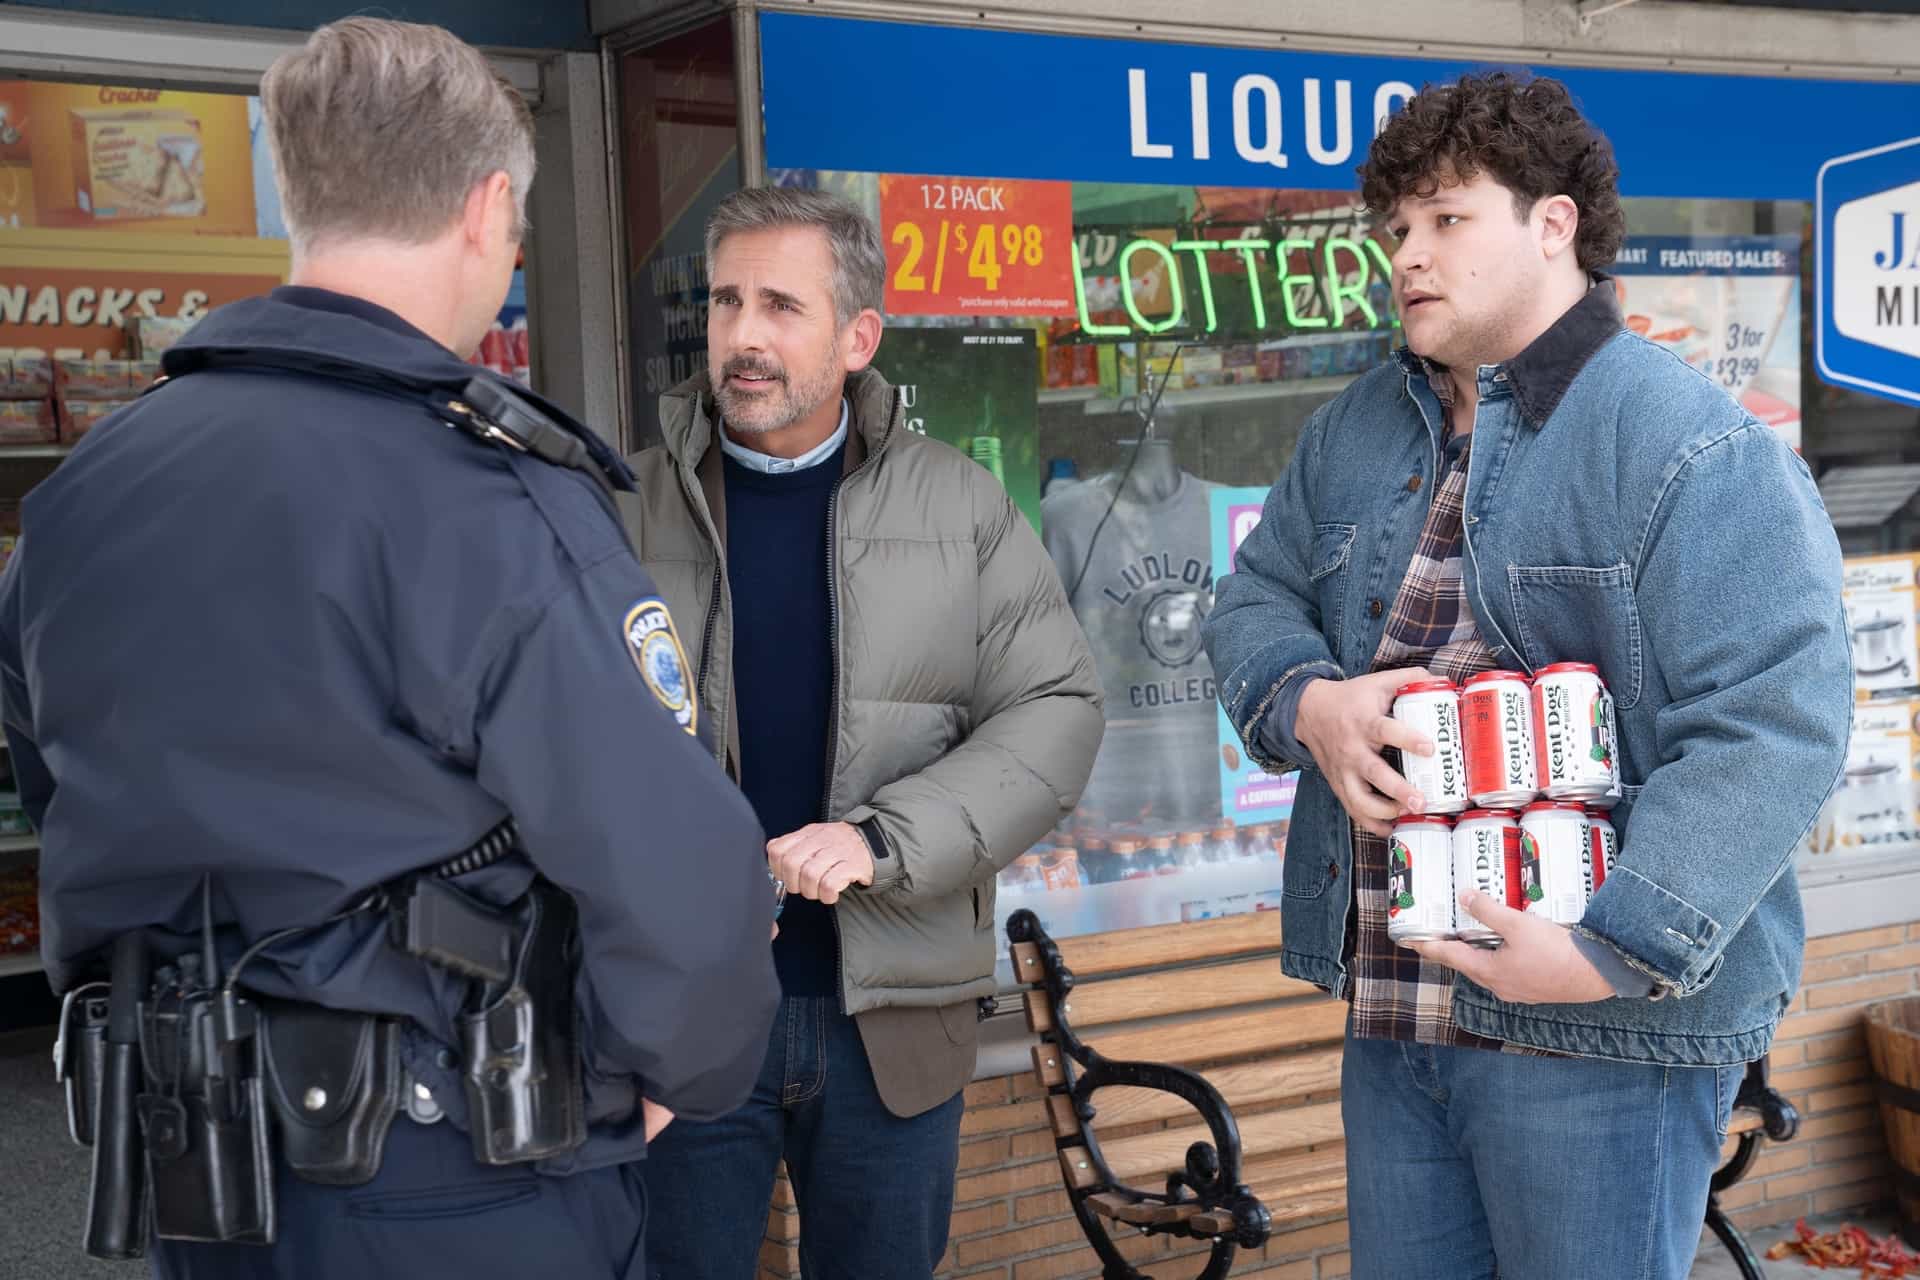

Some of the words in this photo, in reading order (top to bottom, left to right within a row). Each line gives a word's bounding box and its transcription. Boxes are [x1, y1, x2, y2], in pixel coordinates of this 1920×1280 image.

[1128, 69, 1420, 168] LIQU
[920, 184, 946, 209] 12
[951, 185, 1005, 211] PACK
[1660, 249, 1735, 267] FEATURED
[1874, 211, 1920, 270] J
[1725, 322, 1741, 351] 3
[1742, 326, 1765, 348] for
[1434, 702, 1451, 743] Dog
[1503, 690, 1519, 732] Dog
[1545, 684, 1562, 726] Dog
[1439, 747, 1457, 796] Kent
[1507, 738, 1522, 785] Kent
[1549, 732, 1565, 780] Kent
[1474, 829, 1492, 871] Dog
[1580, 823, 1592, 864] Dog
[1477, 876, 1491, 896] nt
[1582, 869, 1593, 905] ent
